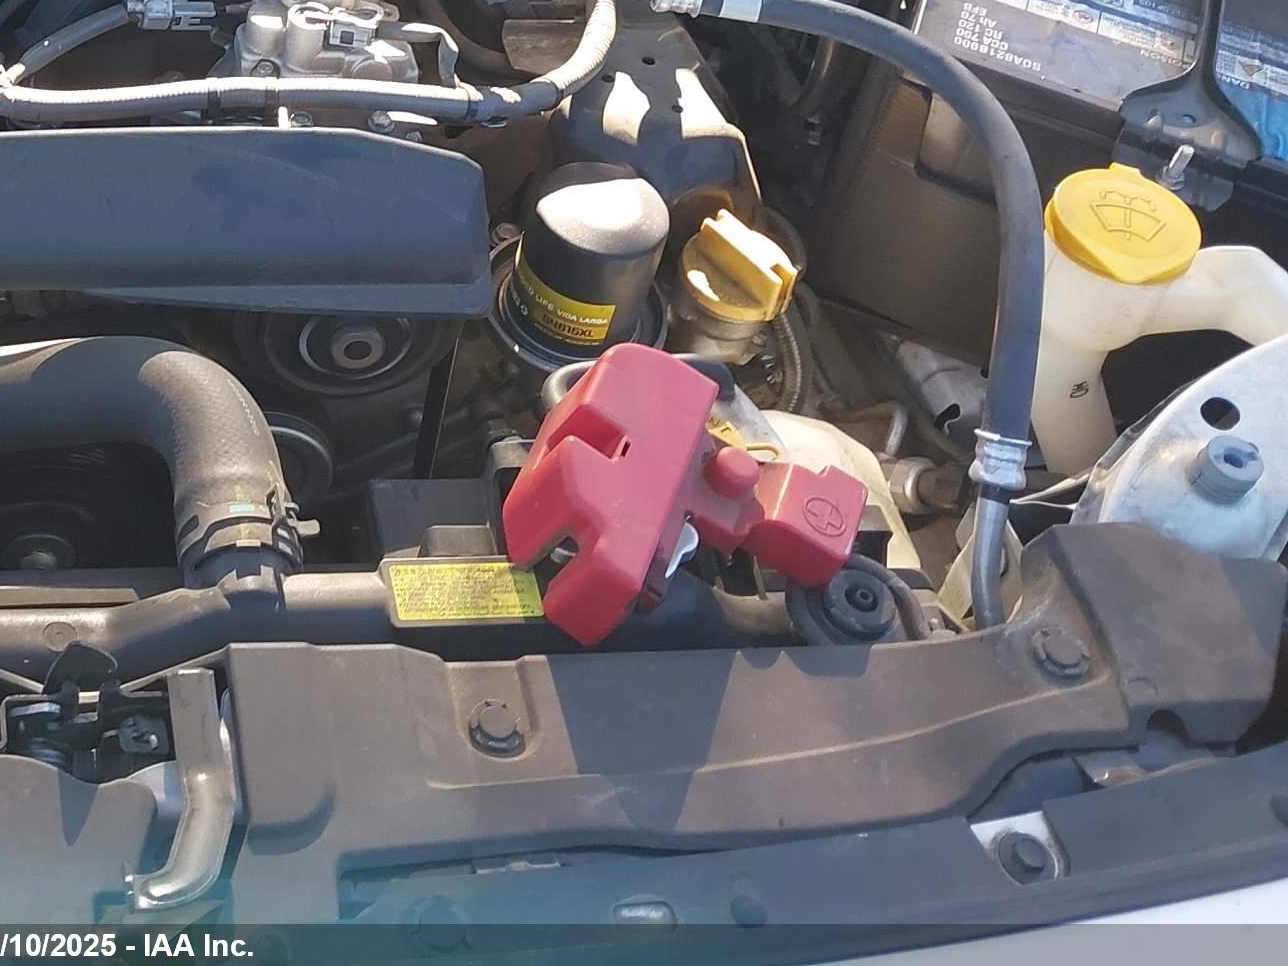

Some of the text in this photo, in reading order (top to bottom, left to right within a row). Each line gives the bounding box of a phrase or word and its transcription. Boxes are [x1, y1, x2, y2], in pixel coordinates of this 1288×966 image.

[963, 3, 987, 16] EFB
[961, 11, 976, 23] 70
[958, 19, 1003, 40] RC 120
[983, 36, 1009, 51] CCA
